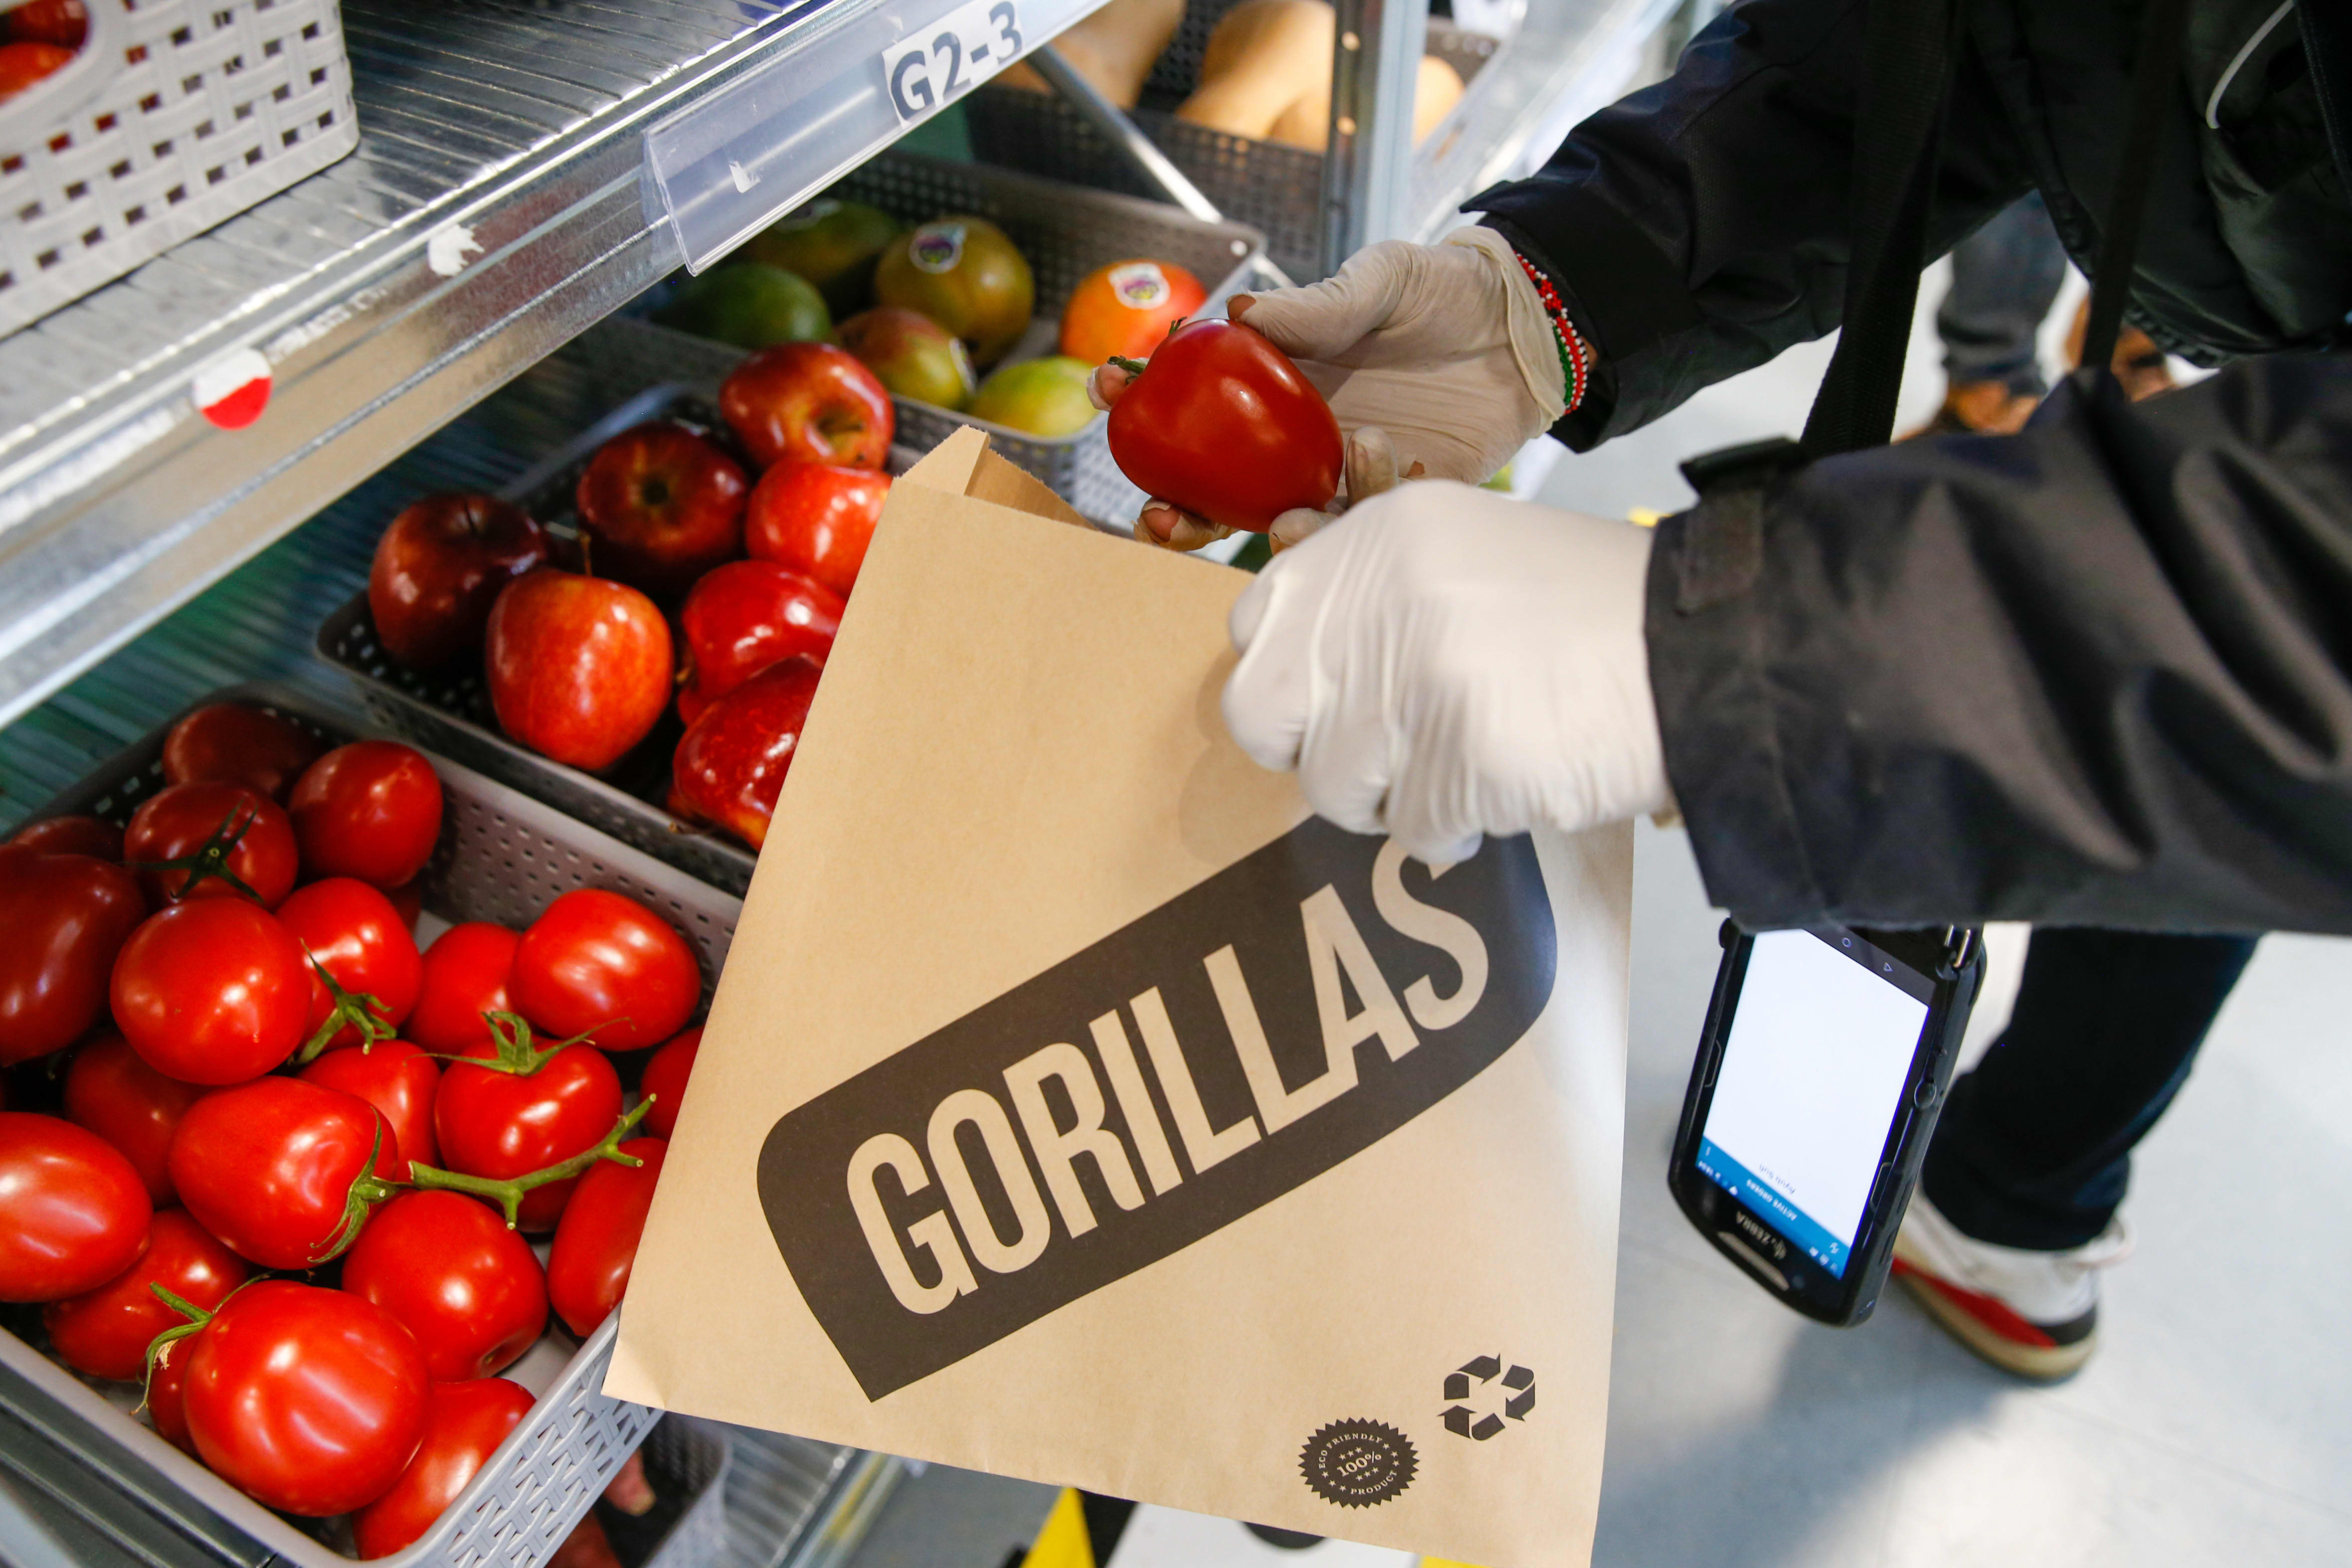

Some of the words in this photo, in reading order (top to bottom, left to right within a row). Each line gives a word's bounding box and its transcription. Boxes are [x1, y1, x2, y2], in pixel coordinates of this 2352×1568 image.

[891, 1, 1022, 121] G2-3
[846, 834, 1488, 1315] GORILLAS
[1746, 1178, 1774, 1203] ORDERS
[1772, 1198, 1798, 1221] ACTIVE
[1736, 1211, 1771, 1245] ZEBRA
[1318, 1450, 1328, 1469] ECO
[1326, 1432, 1383, 1449] FRIENDLY
[1336, 1451, 1382, 1477] 100%
[1350, 1470, 1397, 1495] PRODUCT
